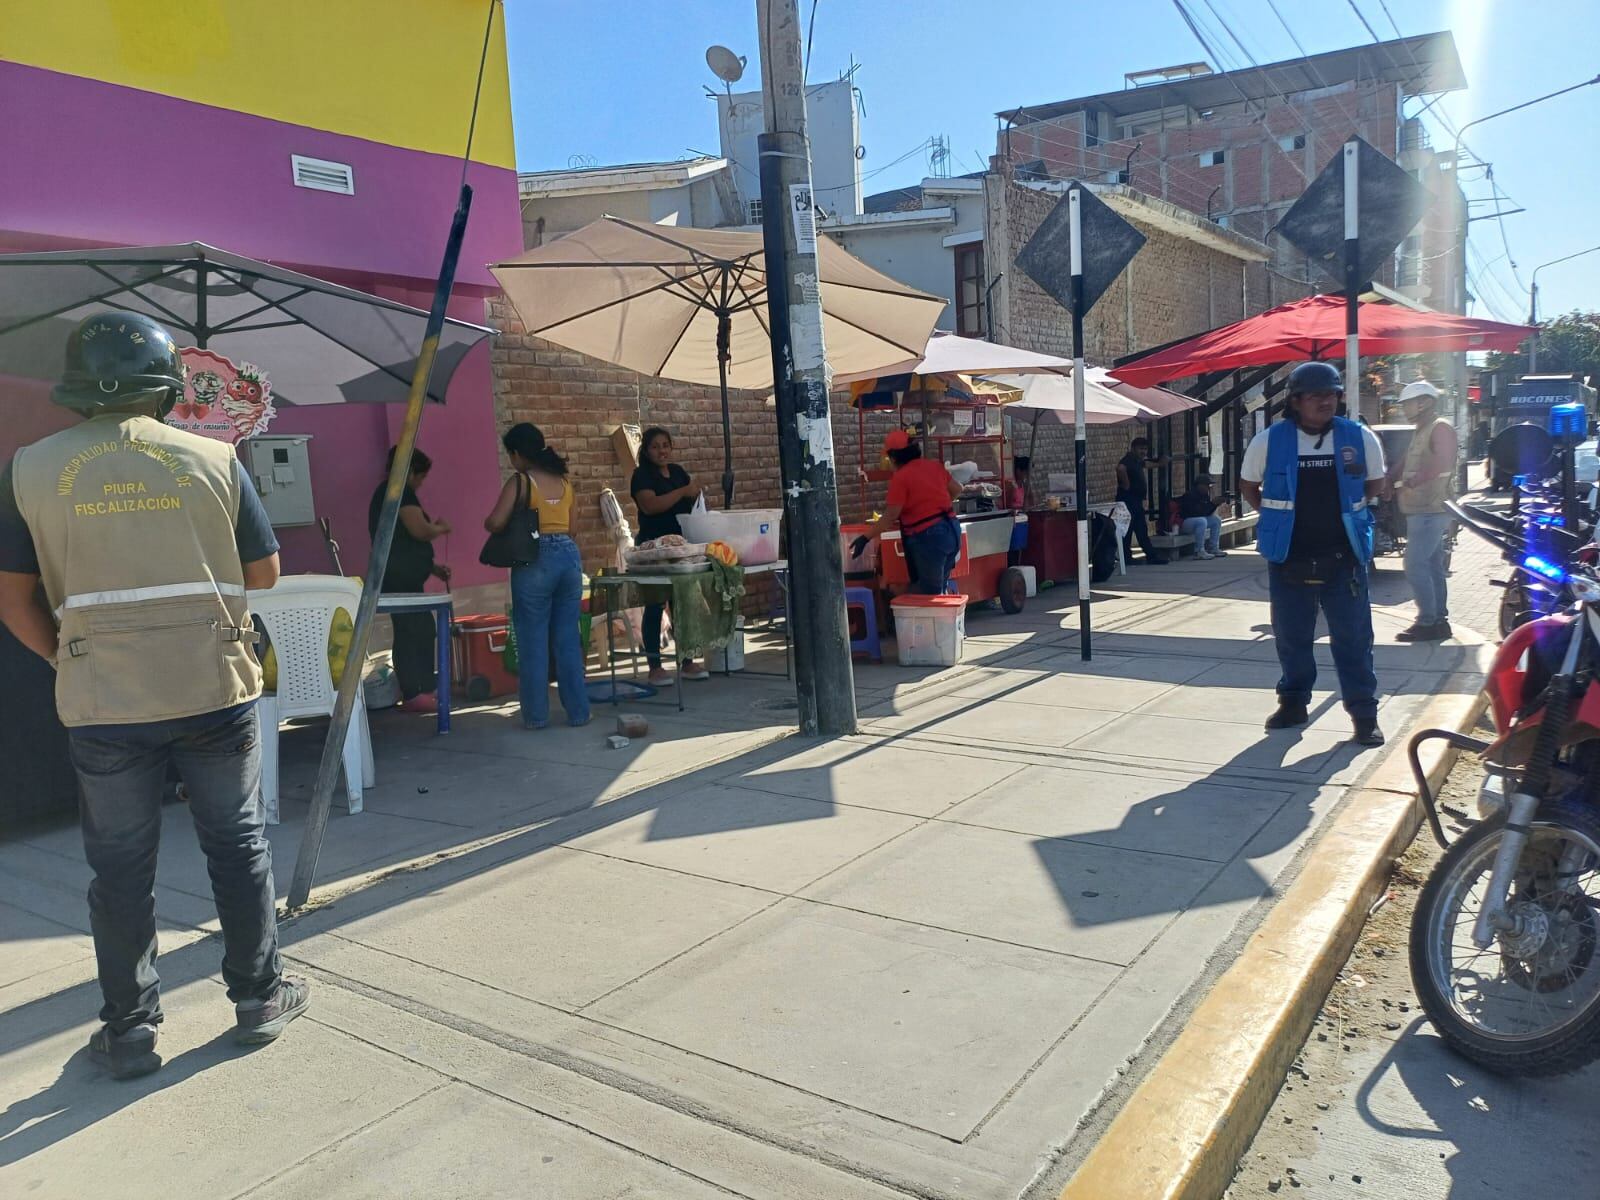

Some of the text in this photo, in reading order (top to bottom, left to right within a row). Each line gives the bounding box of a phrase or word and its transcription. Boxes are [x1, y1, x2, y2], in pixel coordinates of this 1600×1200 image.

[57, 439, 193, 496] MUNICIPALIDAD PROVINCIAL DE
[1306, 459, 1334, 468] STREET
[103, 481, 147, 496] PIURA
[74, 493, 182, 517] FISCALIZACIÓN
